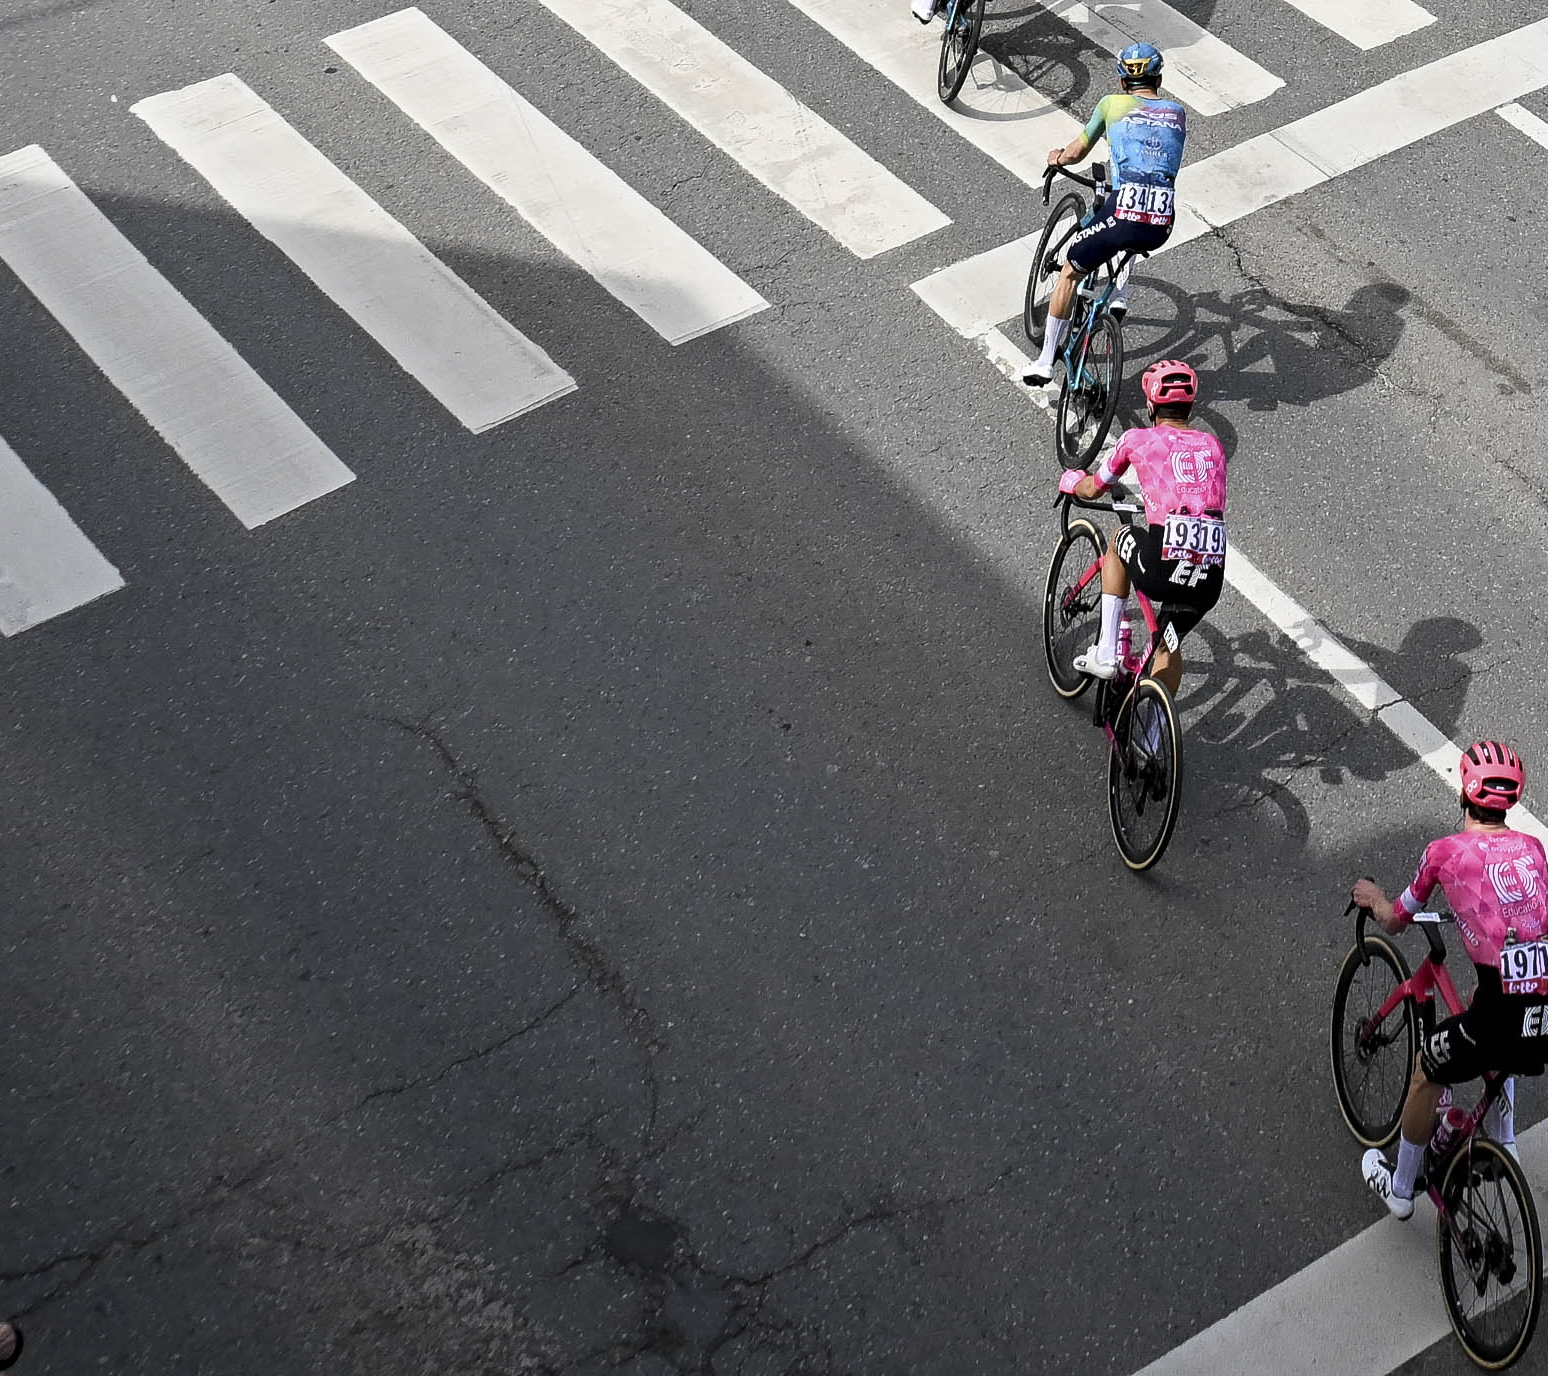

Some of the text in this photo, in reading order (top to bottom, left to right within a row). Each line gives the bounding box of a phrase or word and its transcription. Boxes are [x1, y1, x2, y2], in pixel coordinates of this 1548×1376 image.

[1120, 115, 1182, 131] ASTANA
[1117, 185, 1147, 212] 134
[1071, 221, 1107, 246] ASTANA
[1169, 449, 1214, 484] EF
[1164, 520, 1201, 549] 193
[1168, 560, 1210, 588] EF
[1485, 855, 1540, 906] EF
[1502, 898, 1542, 919] Education
[1502, 945, 1540, 981] 197
[1431, 1029, 1452, 1065] EF
